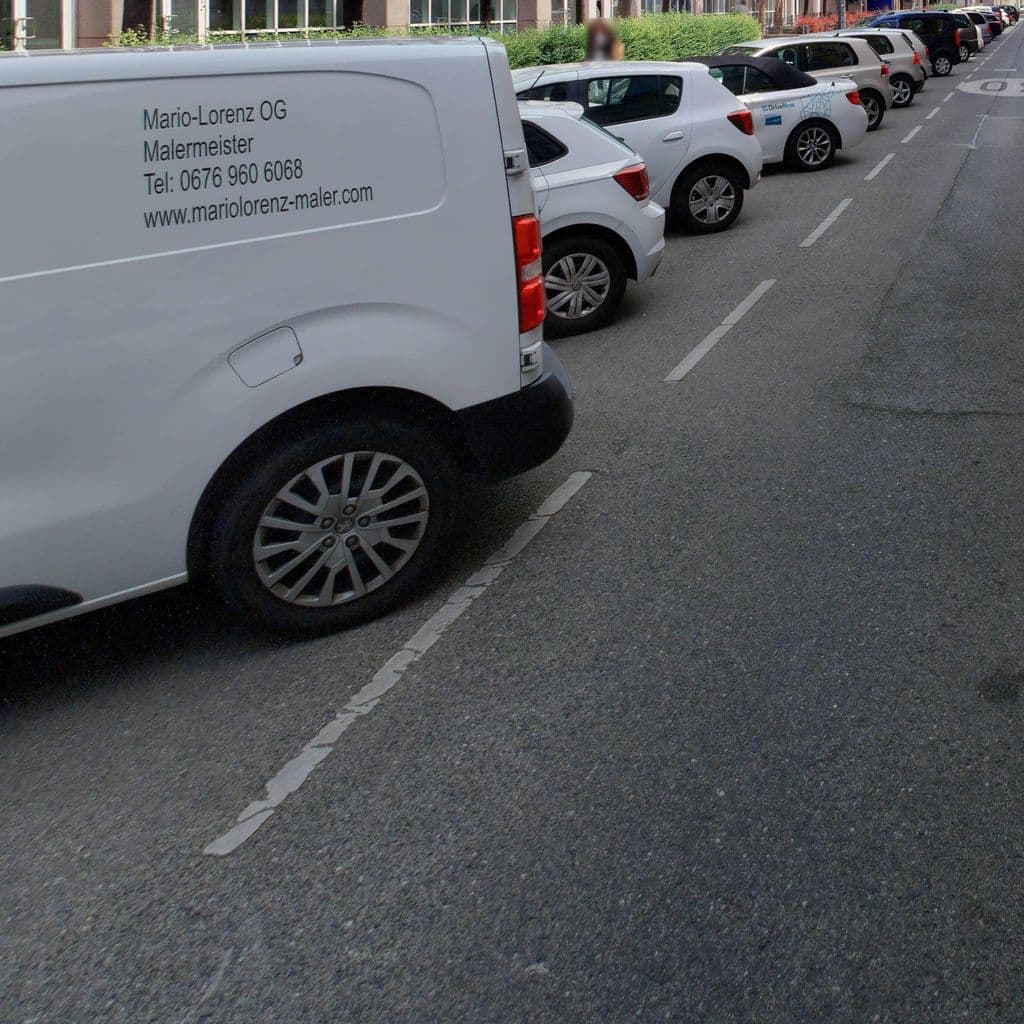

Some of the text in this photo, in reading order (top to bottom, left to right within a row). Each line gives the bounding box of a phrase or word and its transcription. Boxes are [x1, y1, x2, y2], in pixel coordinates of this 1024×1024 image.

[143, 99, 287, 130] Mario-Lorenz OG
[143, 135, 254, 162] Malermeister
[143, 158, 303, 195] Tel: 0676 960 6068
[143, 185, 374, 229] www.mariolorenz-maler.com
